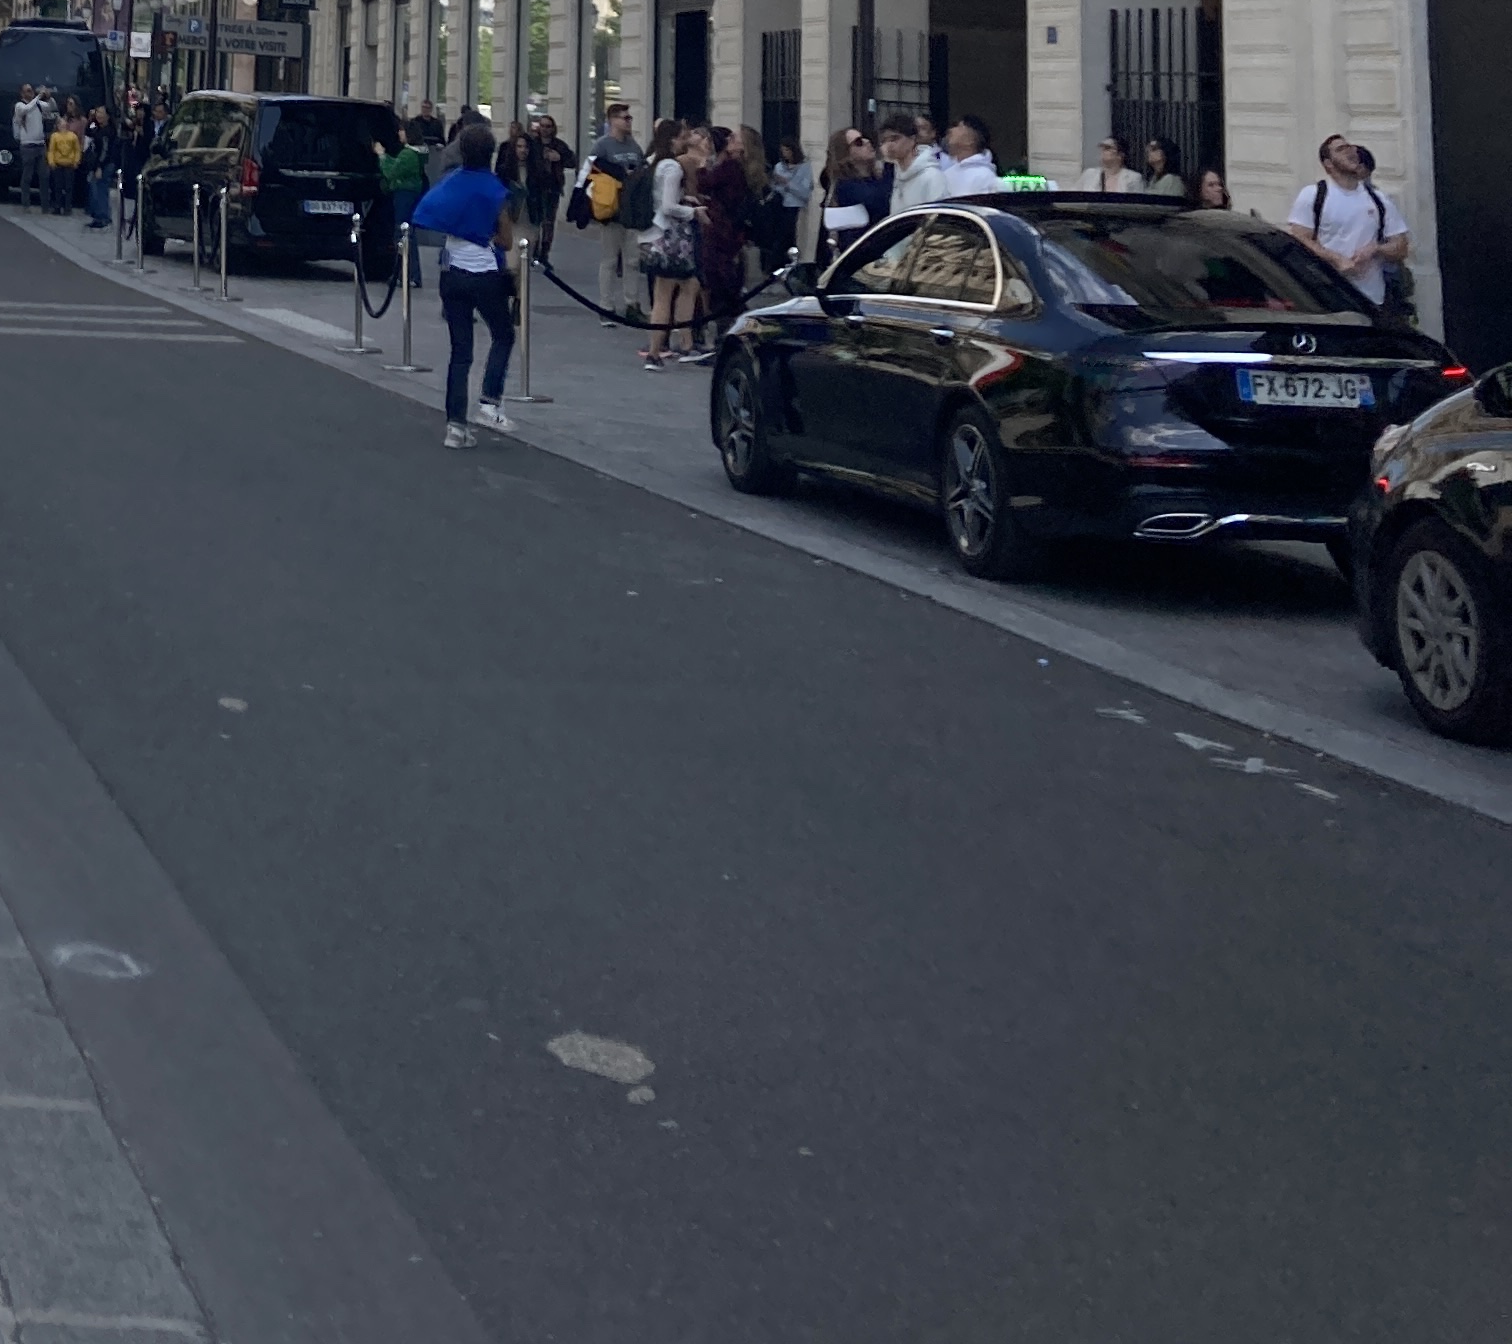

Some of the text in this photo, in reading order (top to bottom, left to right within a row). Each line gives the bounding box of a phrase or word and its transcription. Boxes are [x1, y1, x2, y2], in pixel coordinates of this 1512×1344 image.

[224, 37, 257, 51] VOTRE
[258, 40, 287, 53] VISITE
[1252, 374, 1358, 400] FX-672-JG
